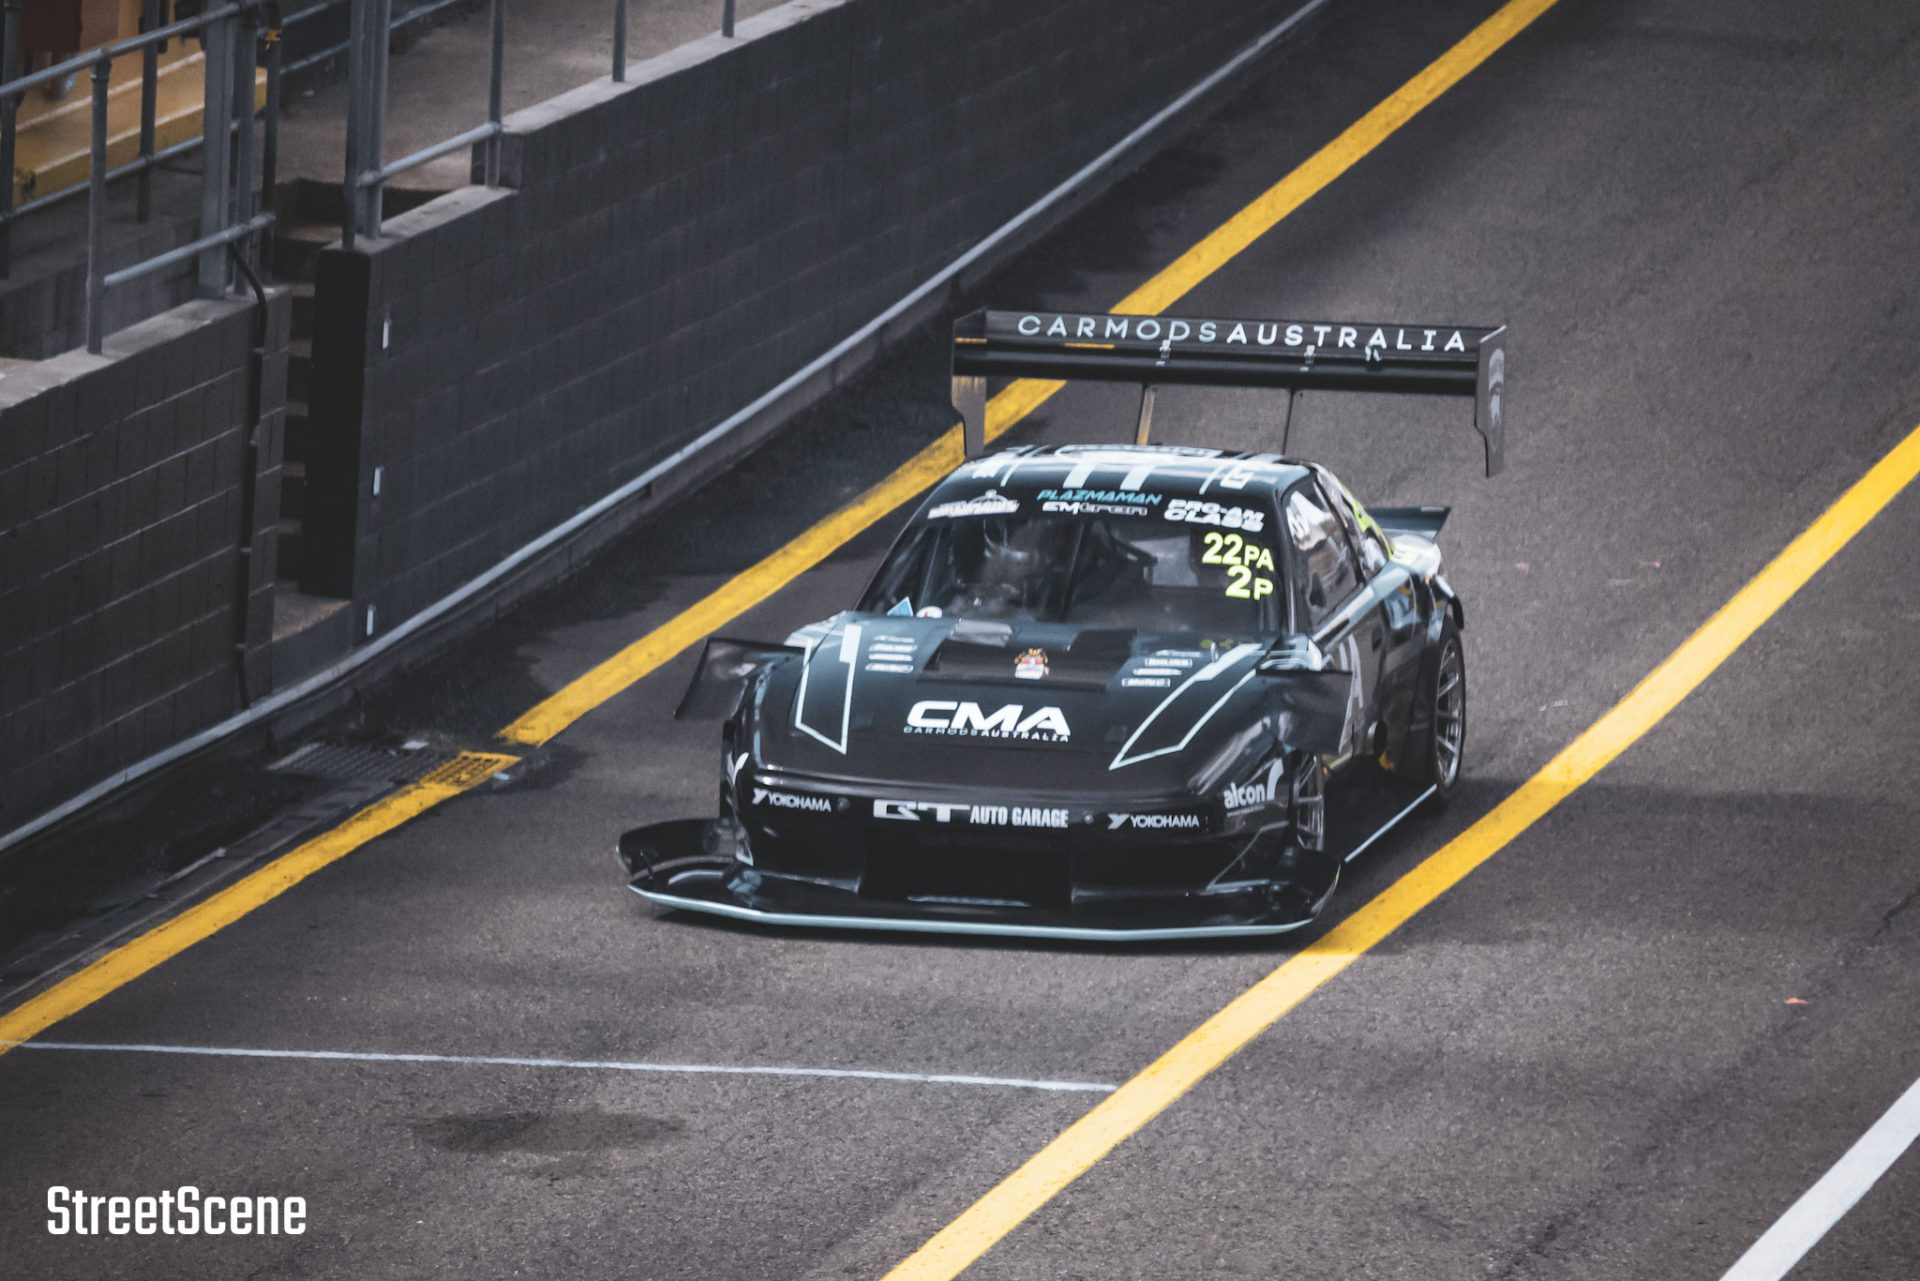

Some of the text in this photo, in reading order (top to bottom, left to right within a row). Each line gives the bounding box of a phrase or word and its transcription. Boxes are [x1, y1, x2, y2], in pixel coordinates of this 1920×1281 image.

[1036, 488, 1163, 506] PLAZMAMAN
[906, 700, 1072, 736] CMA
[767, 791, 832, 812] YOKOHAMA
[1223, 781, 1266, 811] alcon
[872, 798, 1069, 829] GT AUTO GARAGE
[1130, 814, 1201, 829] YOKOHAMA
